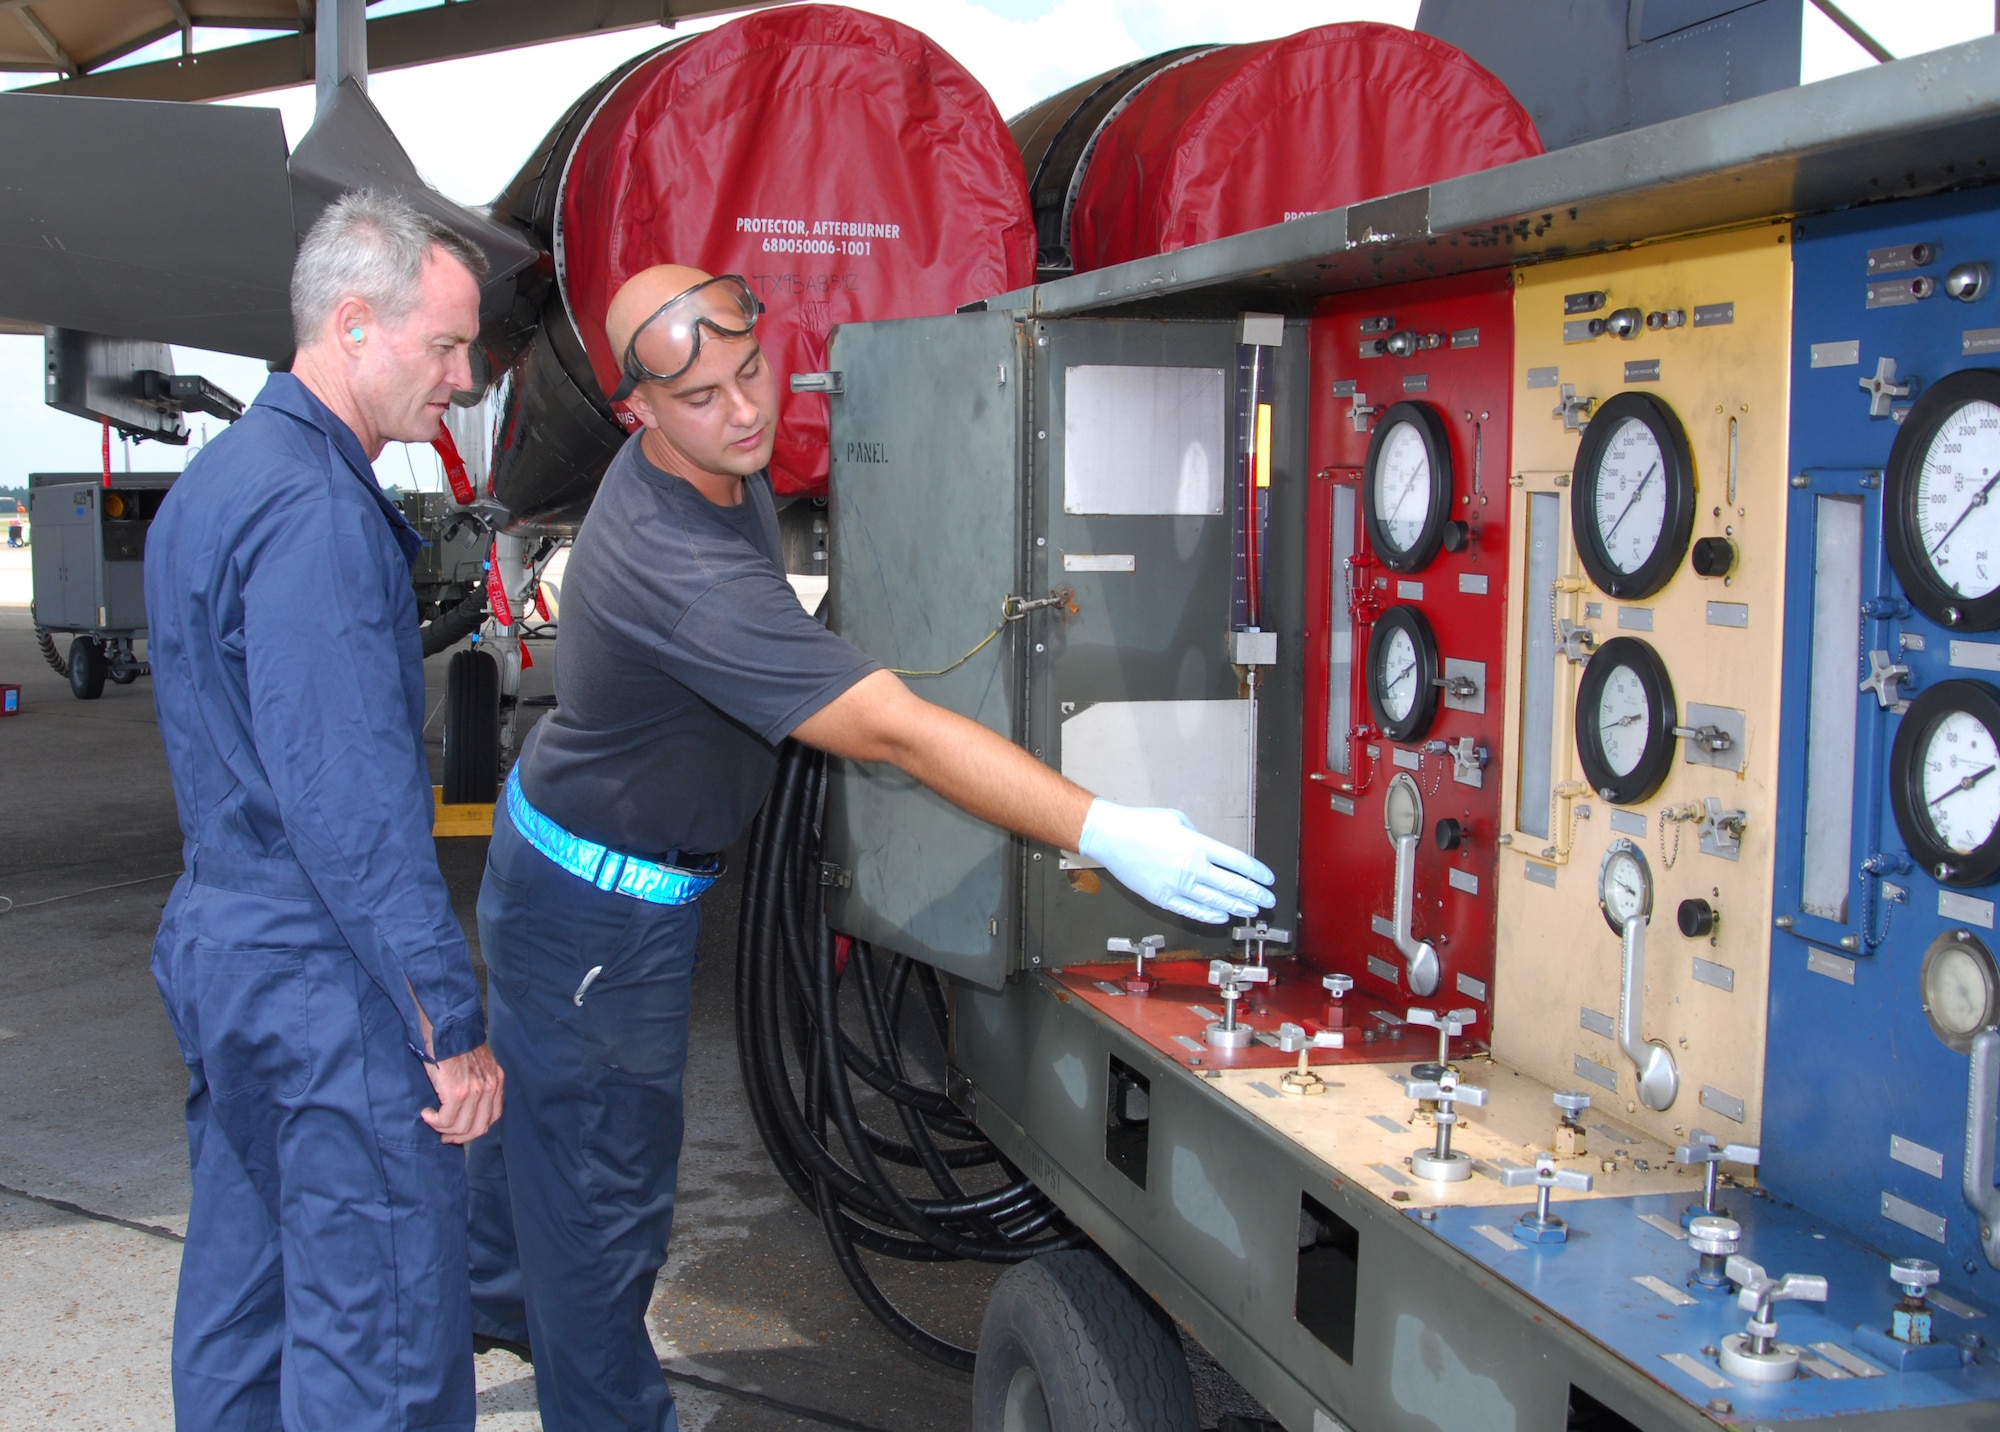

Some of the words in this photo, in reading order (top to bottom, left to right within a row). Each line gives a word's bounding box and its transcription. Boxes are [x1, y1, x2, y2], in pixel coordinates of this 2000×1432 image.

[736, 217, 809, 238] PROTECTOR,
[812, 220, 900, 239] AFTERBURNER
[762, 238, 871, 256] 68D050006-1001
[1979, 419, 1998, 429] 3000
[1959, 426, 1976, 436] 2500
[847, 441, 889, 464] PANEL
[1944, 444, 1962, 453] 2000
[1936, 465, 1952, 474] 1500
[1931, 494, 1947, 504] 1000
[1934, 522, 1948, 532] 500
[1944, 544, 1950, 554] 0
[1976, 550, 1988, 561] psi
[492, 590, 507, 617] FLIGHT
[1946, 732, 1958, 743] 100
[1933, 762, 1942, 772] 50
